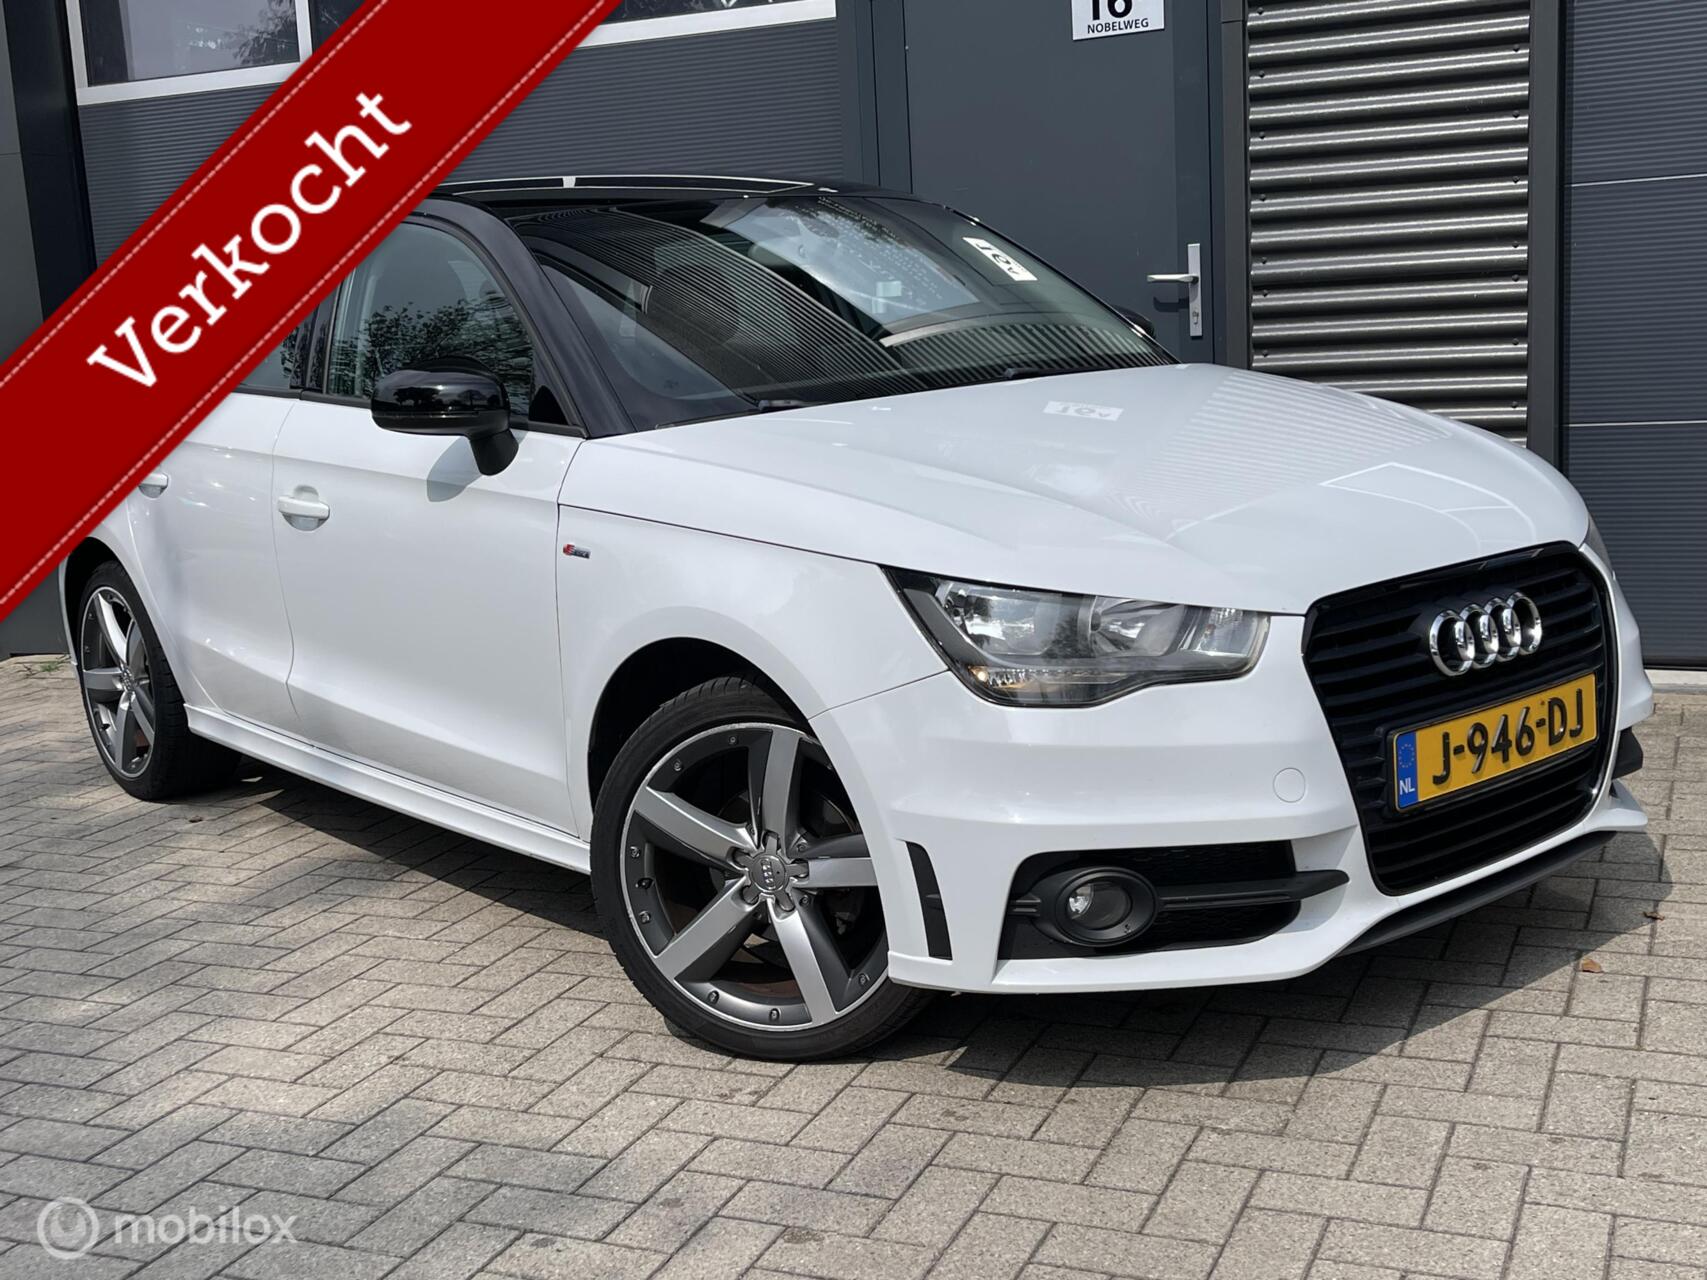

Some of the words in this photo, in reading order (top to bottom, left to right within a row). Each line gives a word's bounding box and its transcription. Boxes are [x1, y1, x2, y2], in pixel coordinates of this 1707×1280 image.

[1087, 18, 1149, 34] NOBELWEG
[1432, 688, 1584, 785] J-946-DJ
[1400, 779, 1416, 795] NL
